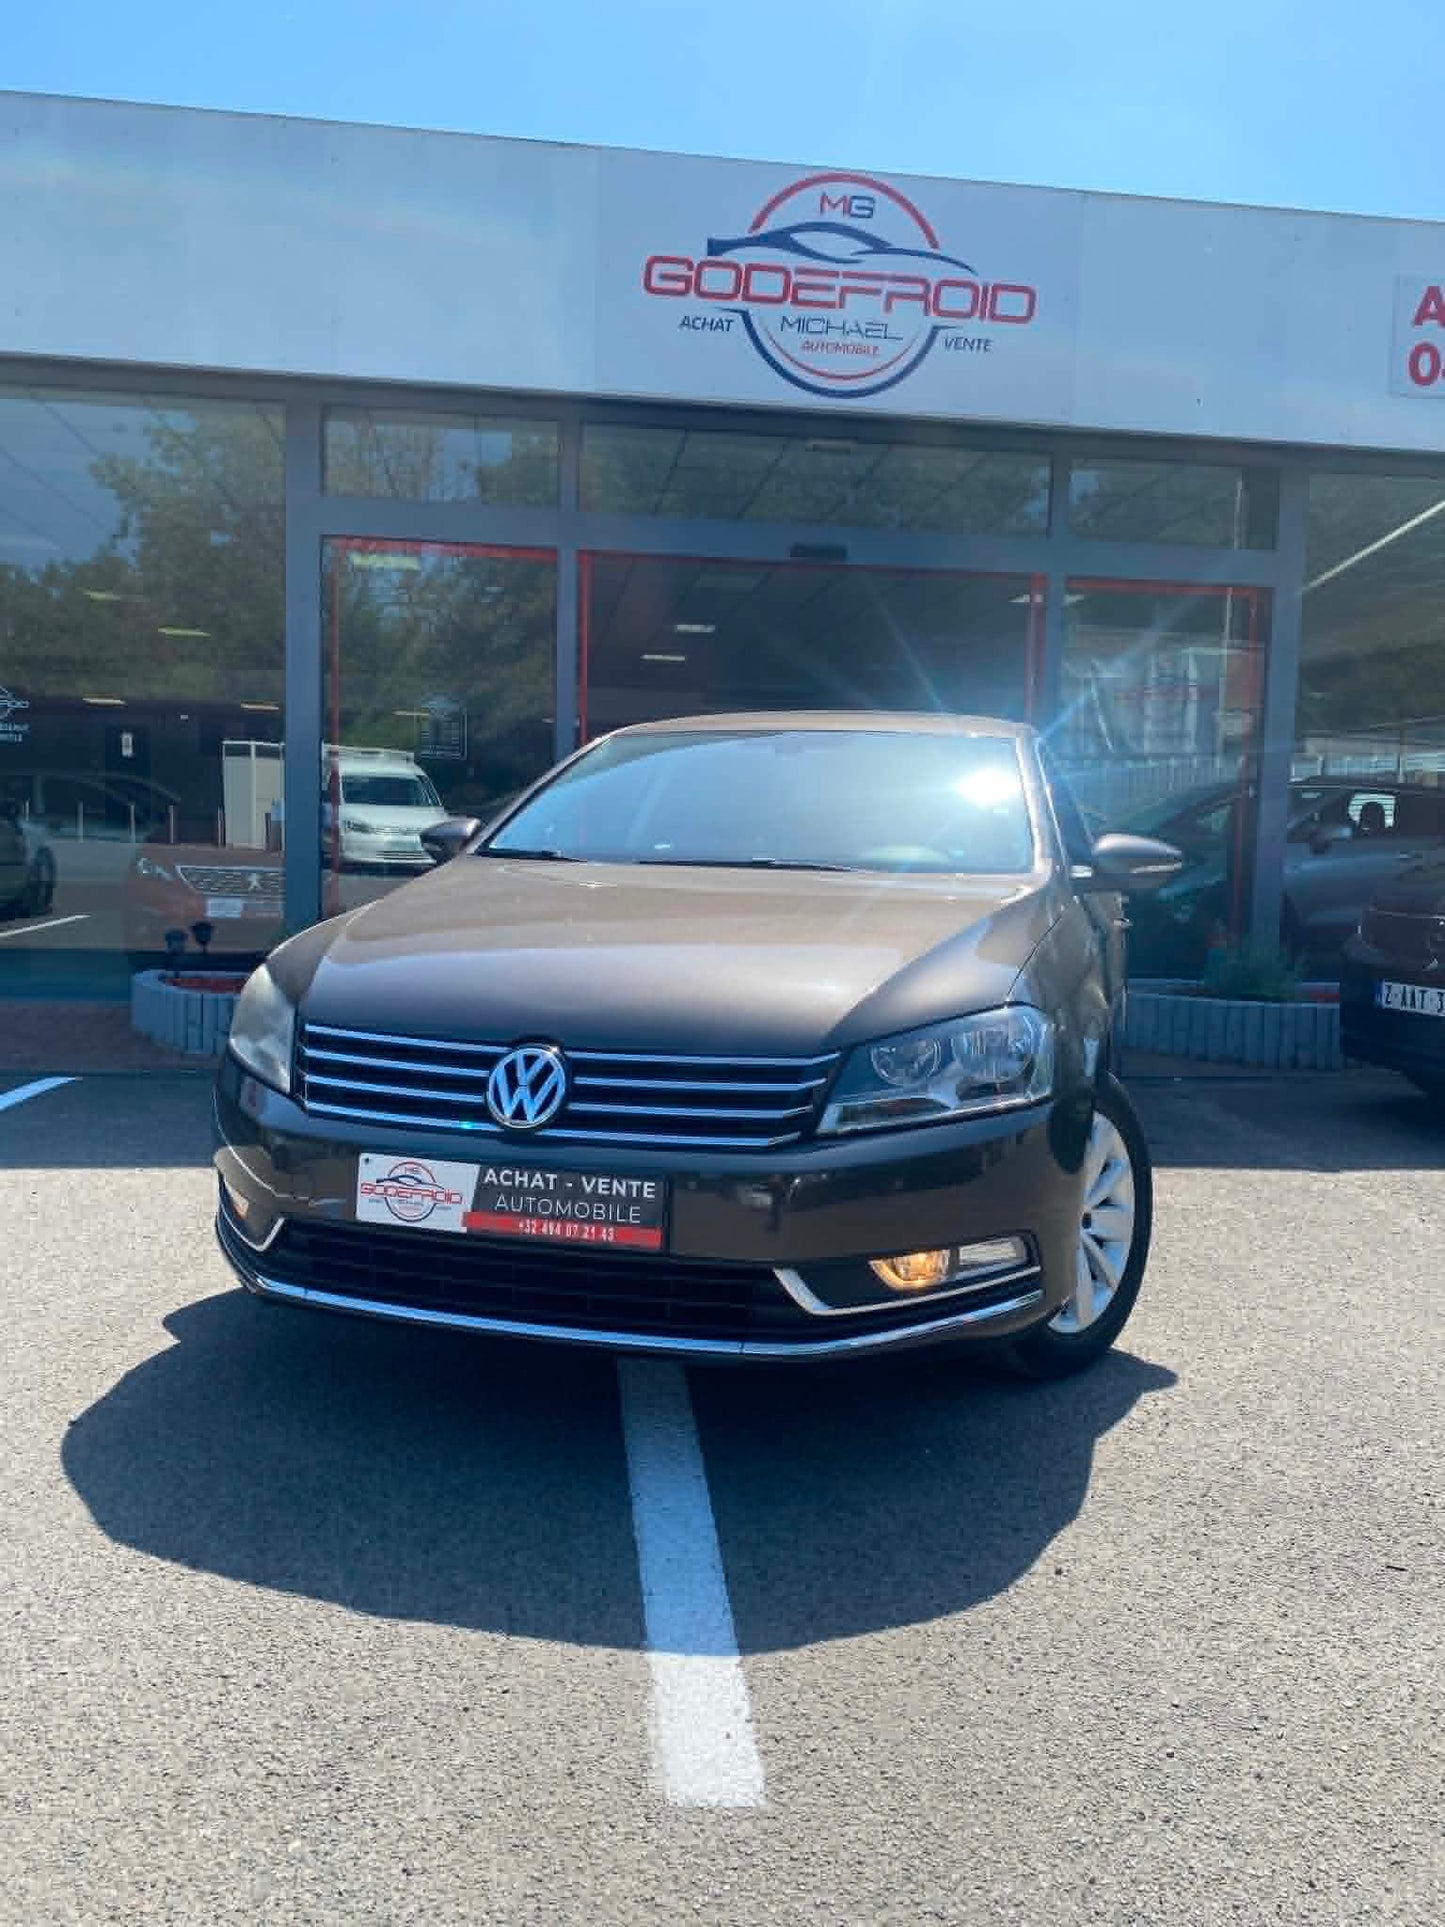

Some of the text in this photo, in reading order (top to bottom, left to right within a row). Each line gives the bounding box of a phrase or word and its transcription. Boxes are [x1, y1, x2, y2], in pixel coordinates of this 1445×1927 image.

[820, 192, 875, 219] MG
[643, 255, 1037, 324] GODEFROID
[679, 315, 734, 332] ACHAT
[780, 316, 904, 341] MICHAEL
[801, 339, 879, 358] AUTOMOBILE
[944, 337, 992, 353] VENTE
[1408, 342, 1445, 386] 0
[483, 1167, 558, 1191] ACHAT
[582, 1175, 657, 1199] VENTE
[494, 1194, 642, 1224] AUTOMOBILE
